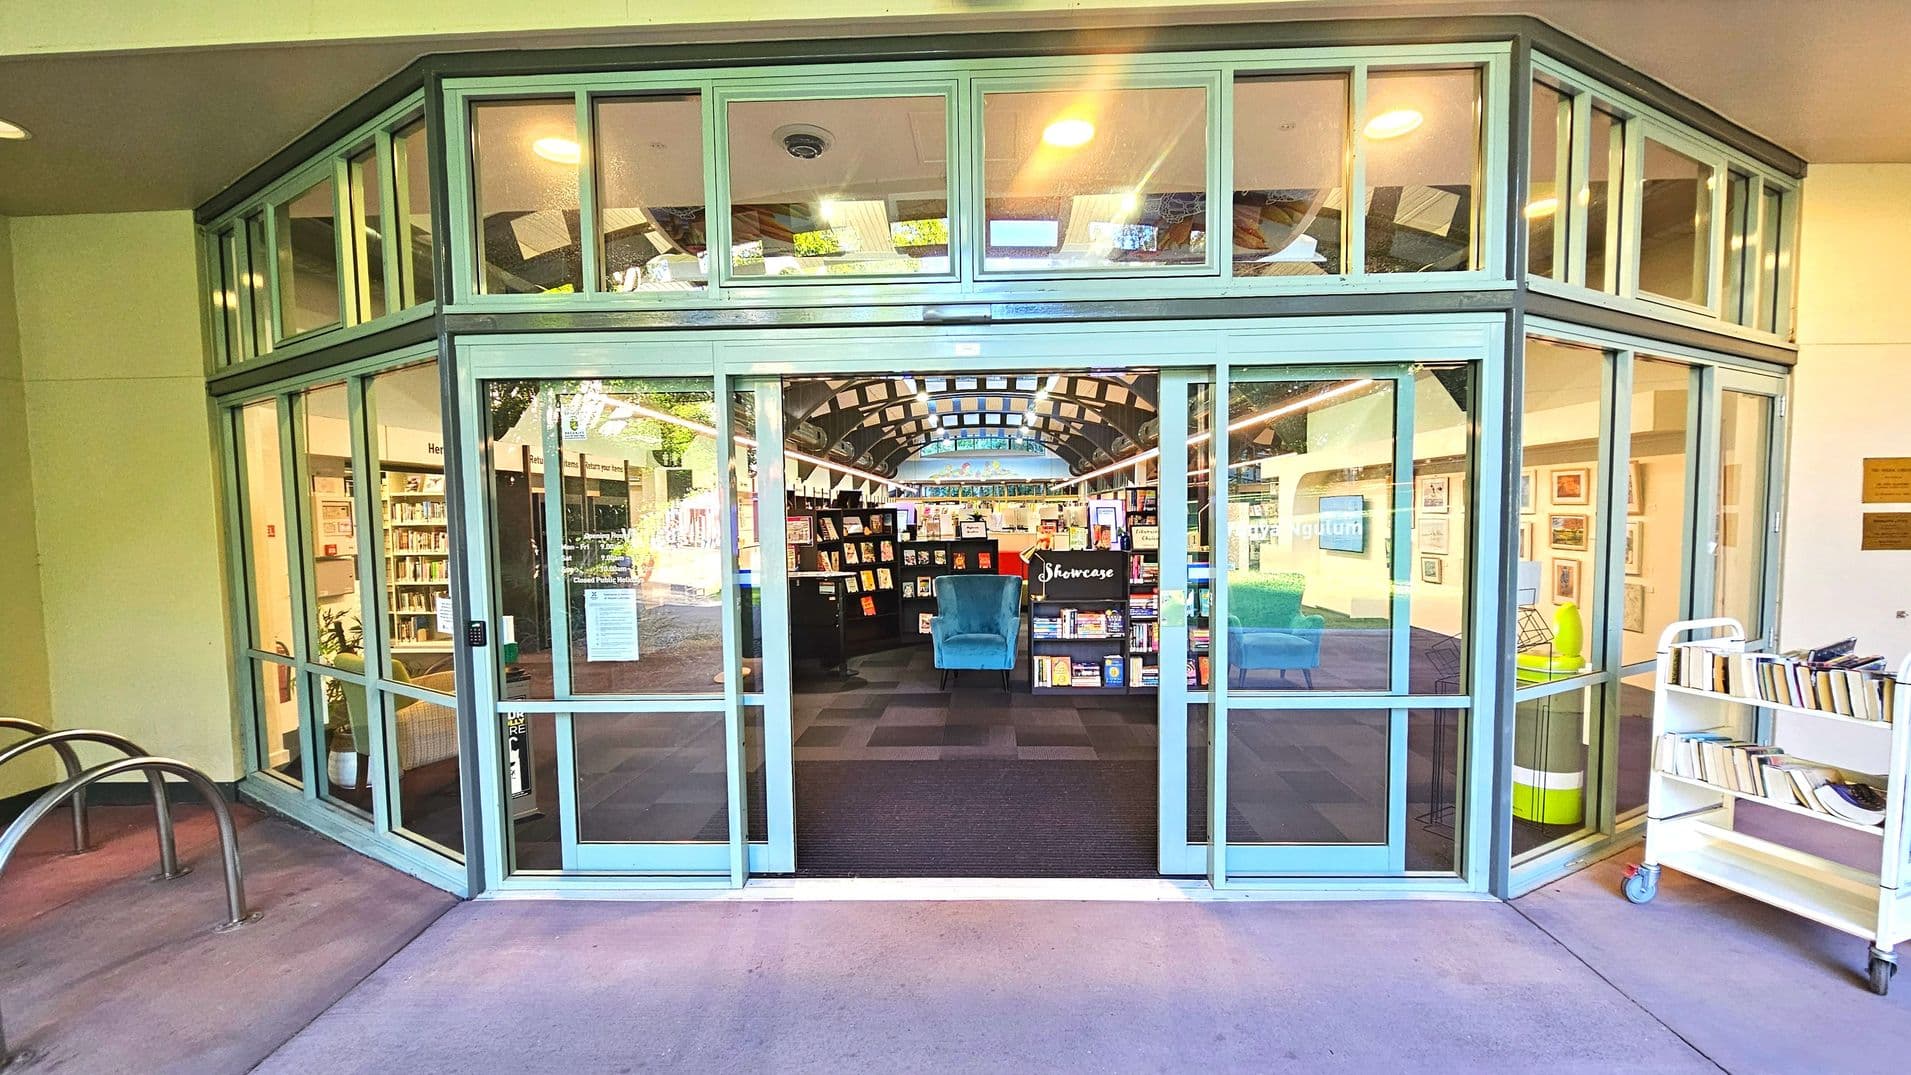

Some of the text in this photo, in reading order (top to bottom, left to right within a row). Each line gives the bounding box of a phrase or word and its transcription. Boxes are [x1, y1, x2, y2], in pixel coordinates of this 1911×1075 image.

[428, 442, 444, 455] Her
[529, 454, 544, 465] Retu
[601, 464, 611, 473] your
[584, 532, 610, 541] Opening
[1038, 562, 1114, 583] Showcase
[509, 724, 526, 736] RE
